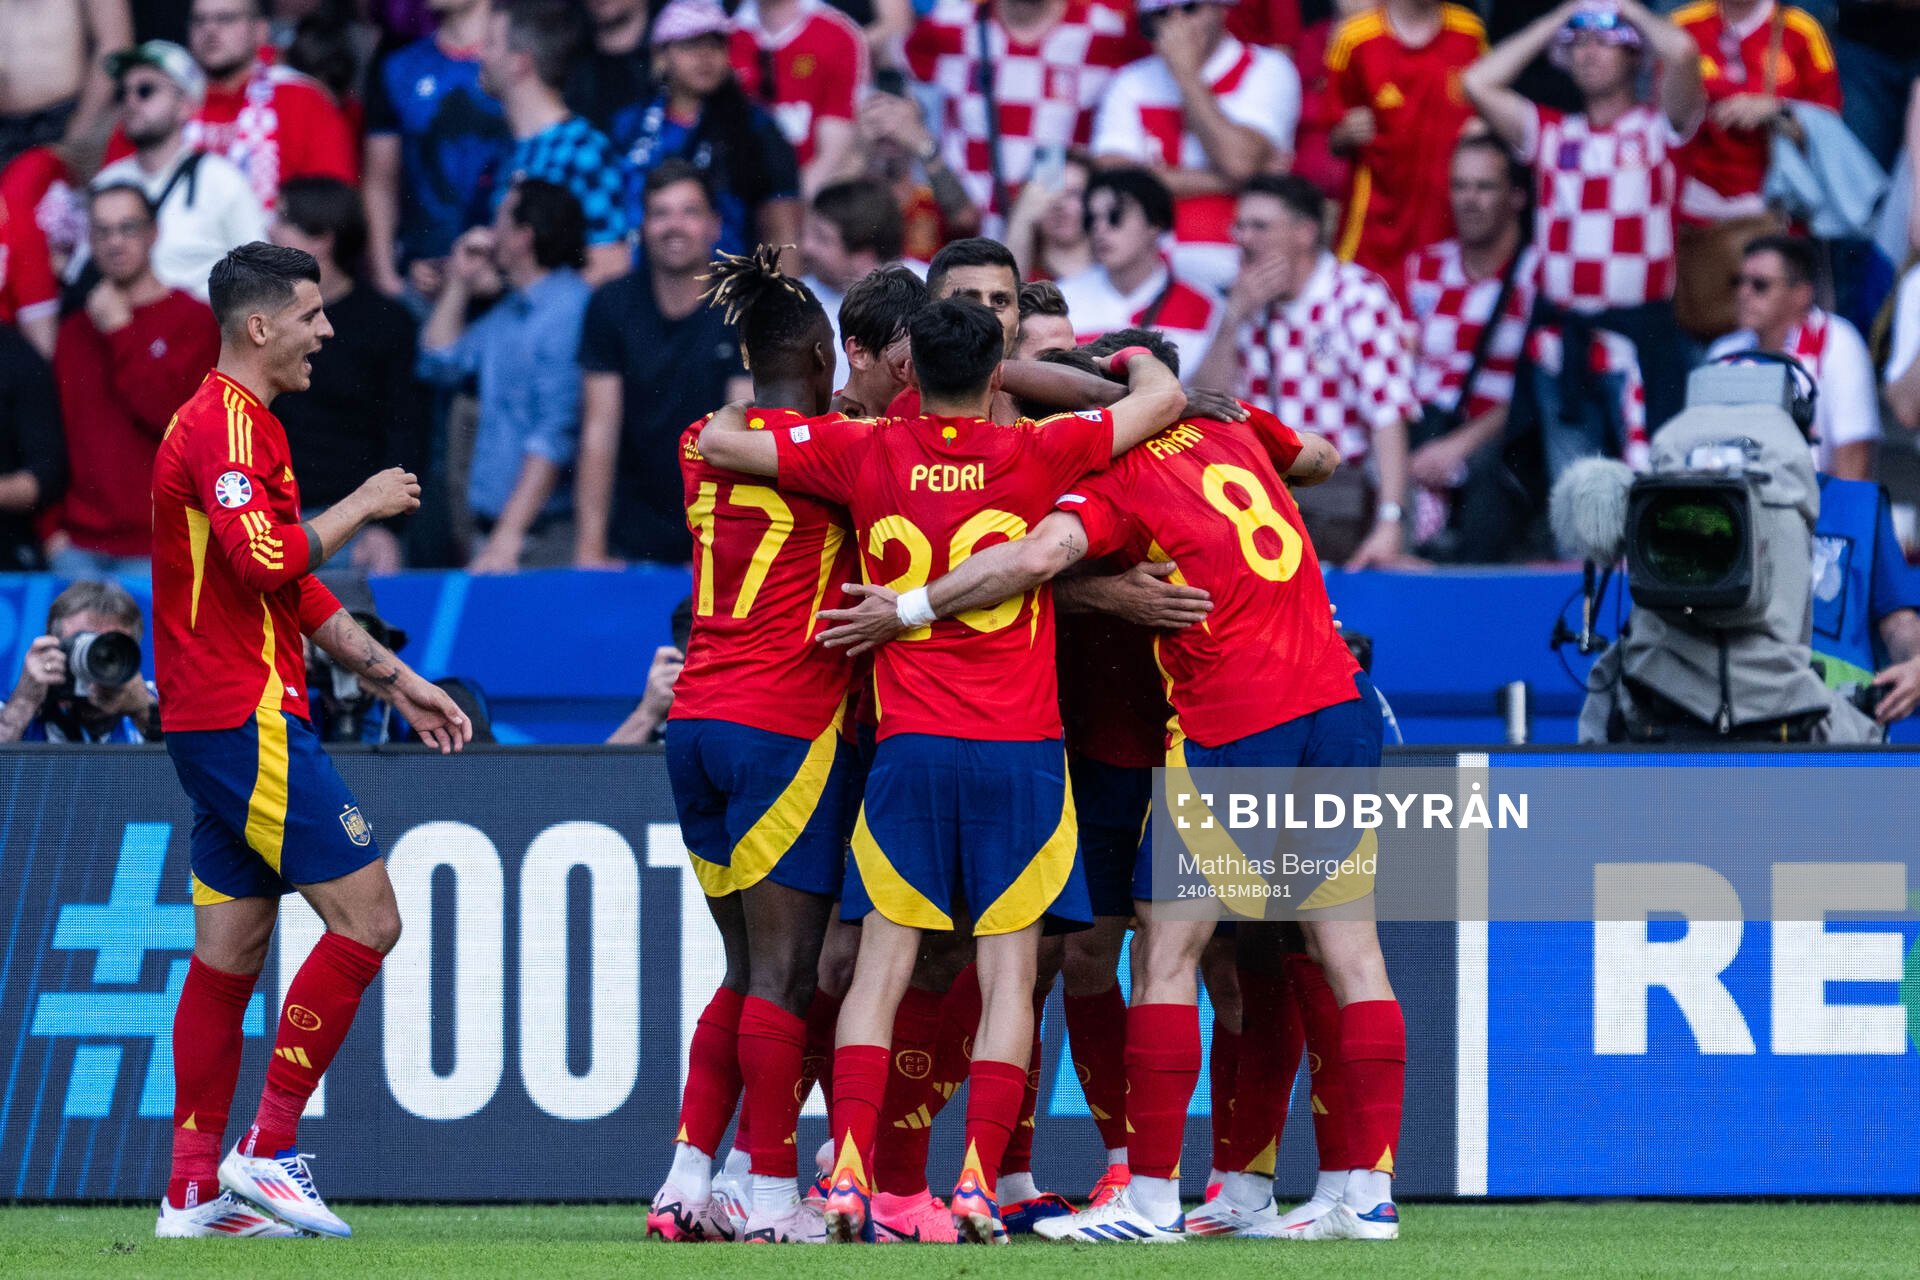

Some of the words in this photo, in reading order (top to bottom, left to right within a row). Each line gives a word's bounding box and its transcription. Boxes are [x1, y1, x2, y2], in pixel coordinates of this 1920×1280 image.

[910, 463, 985, 492] PEDRI
[1202, 463, 1303, 582] 8
[687, 481, 794, 618] 17
